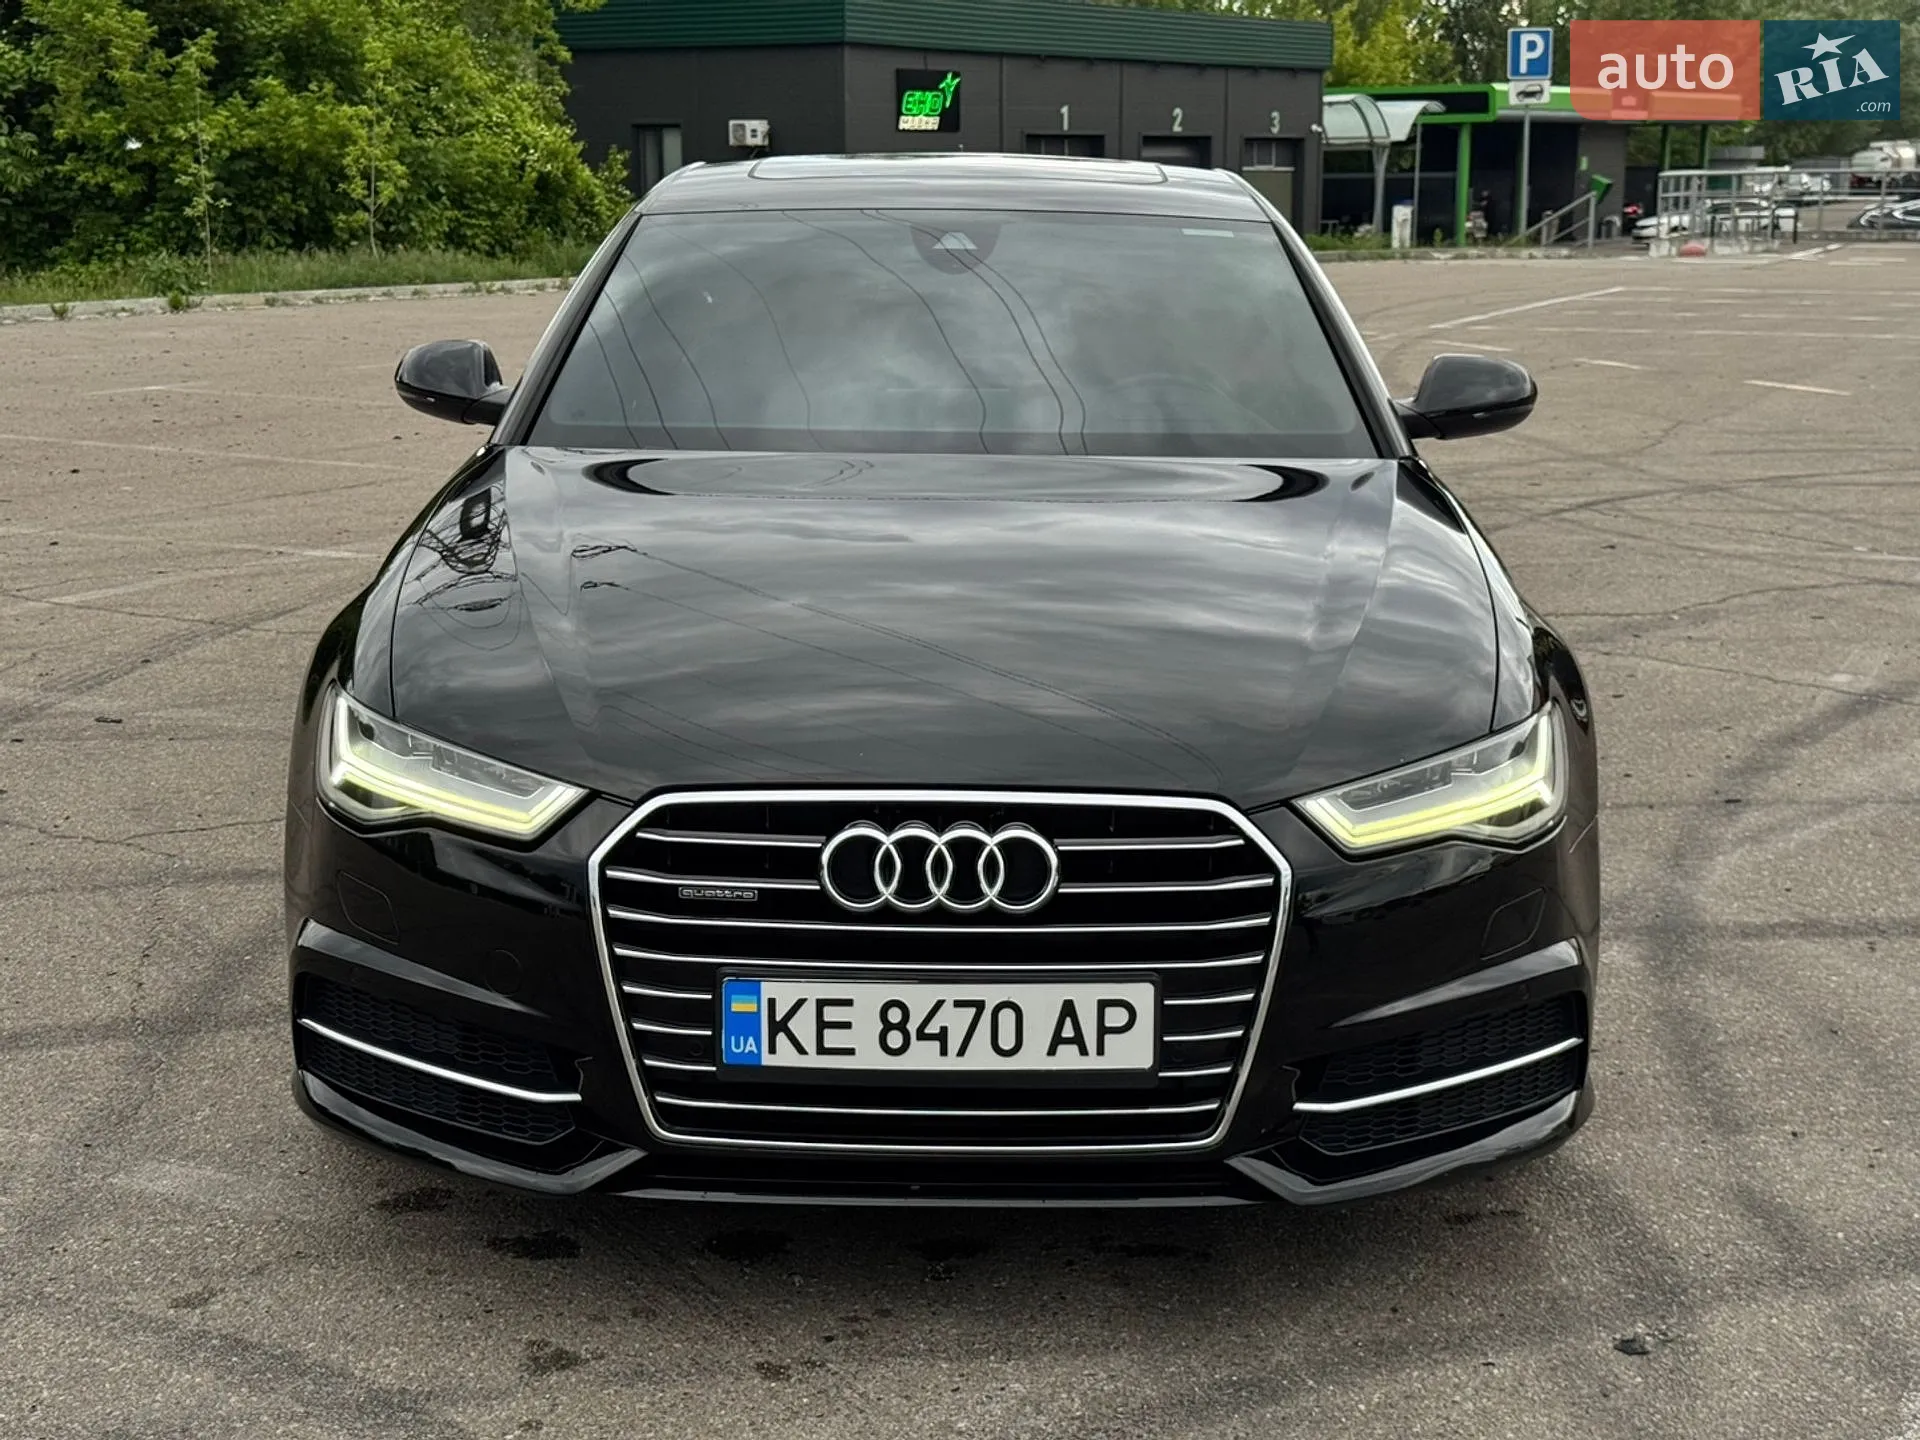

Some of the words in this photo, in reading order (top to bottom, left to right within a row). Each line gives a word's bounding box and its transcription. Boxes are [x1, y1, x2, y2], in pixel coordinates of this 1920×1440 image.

[1520, 33, 1544, 73] P
[1060, 104, 1070, 131] 1
[1172, 107, 1183, 132] 2
[1270, 111, 1280, 134] 3
[682, 888, 754, 899] quattro
[766, 997, 856, 1056] KE
[879, 998, 1024, 1058] 8470
[1047, 998, 1137, 1058] AP
[731, 1036, 758, 1054] UA
